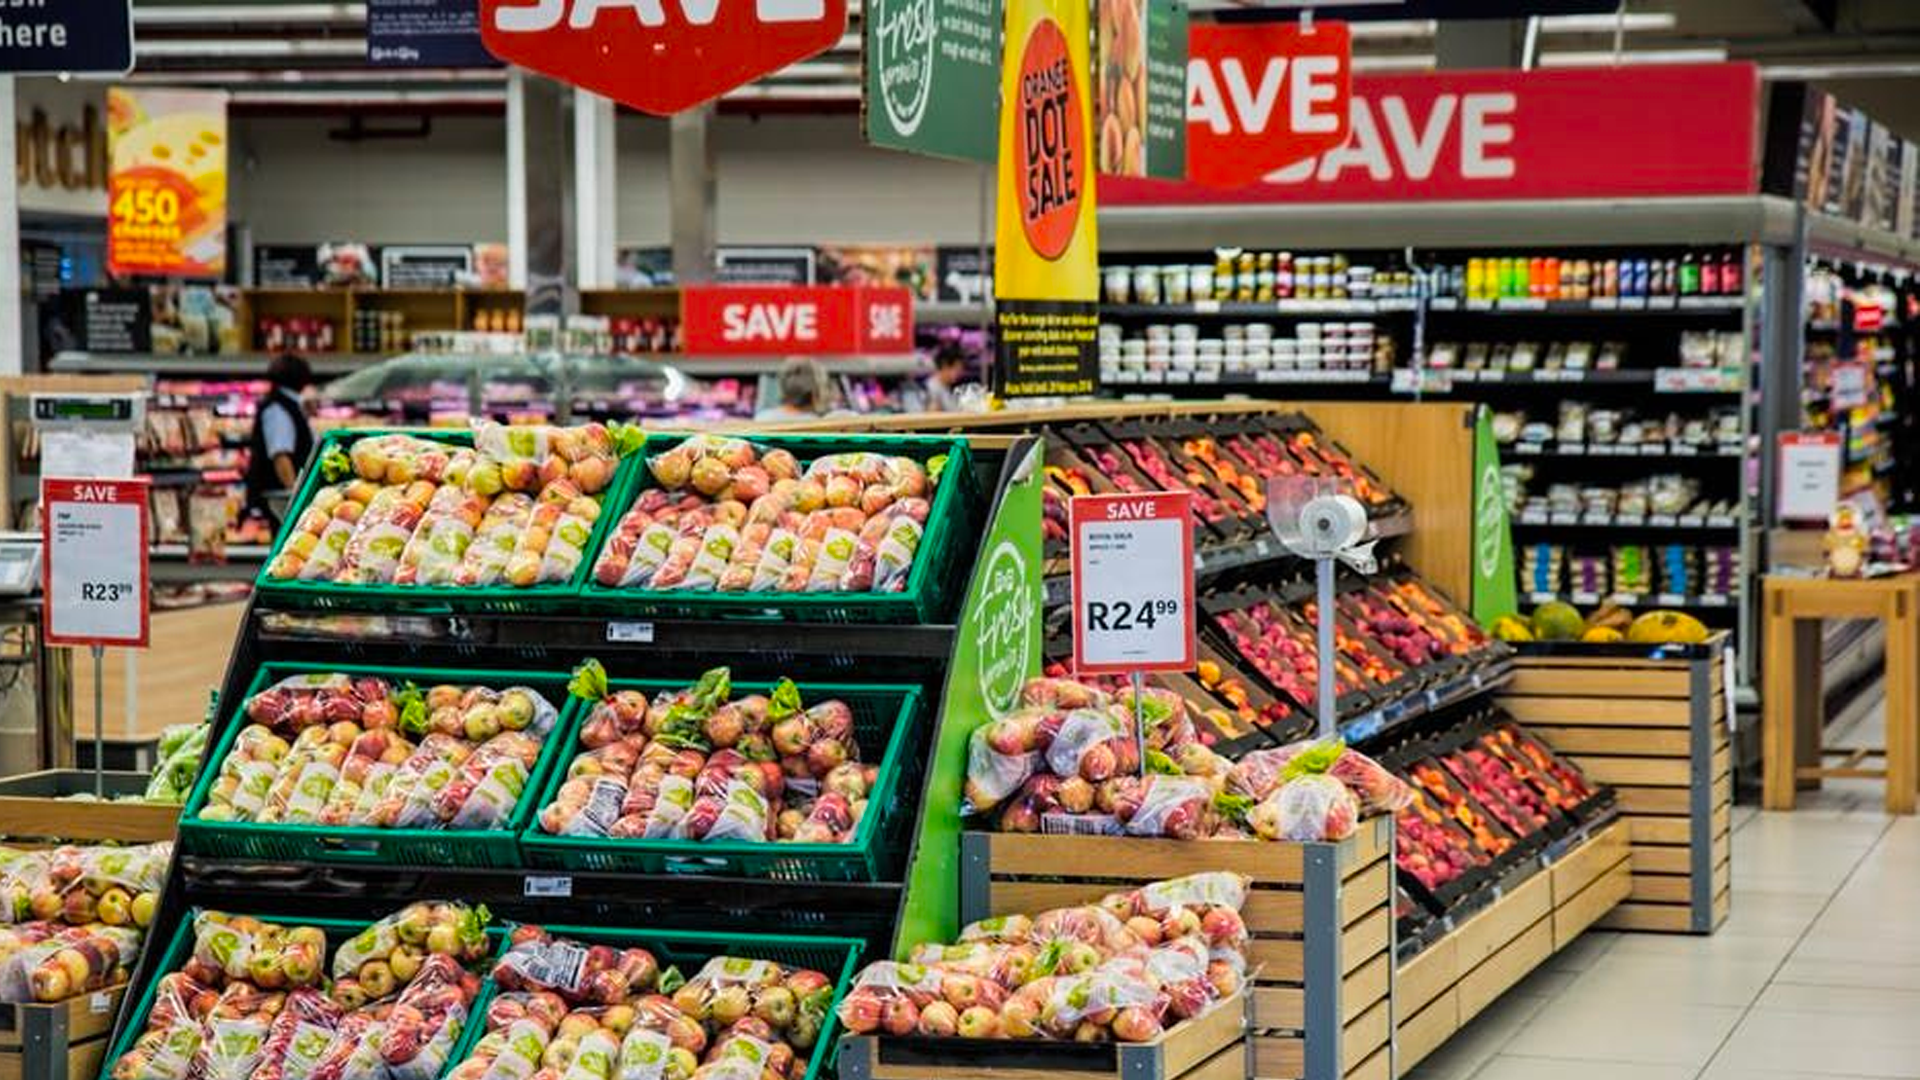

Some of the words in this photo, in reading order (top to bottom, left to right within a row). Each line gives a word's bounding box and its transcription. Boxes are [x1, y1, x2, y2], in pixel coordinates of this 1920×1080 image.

[0, 17, 67, 47] here
[1024, 58, 1068, 105] ORANGE
[1186, 56, 1339, 134] AVE
[1027, 92, 1068, 165] DOT
[1262, 93, 1516, 184] AVE
[114, 188, 178, 223] 450
[1029, 153, 1076, 219] SALE
[723, 303, 819, 341] SAVE
[73, 484, 117, 502] SAVE
[1107, 501, 1156, 519] SAVE
[973, 585, 1036, 659] Fresh
